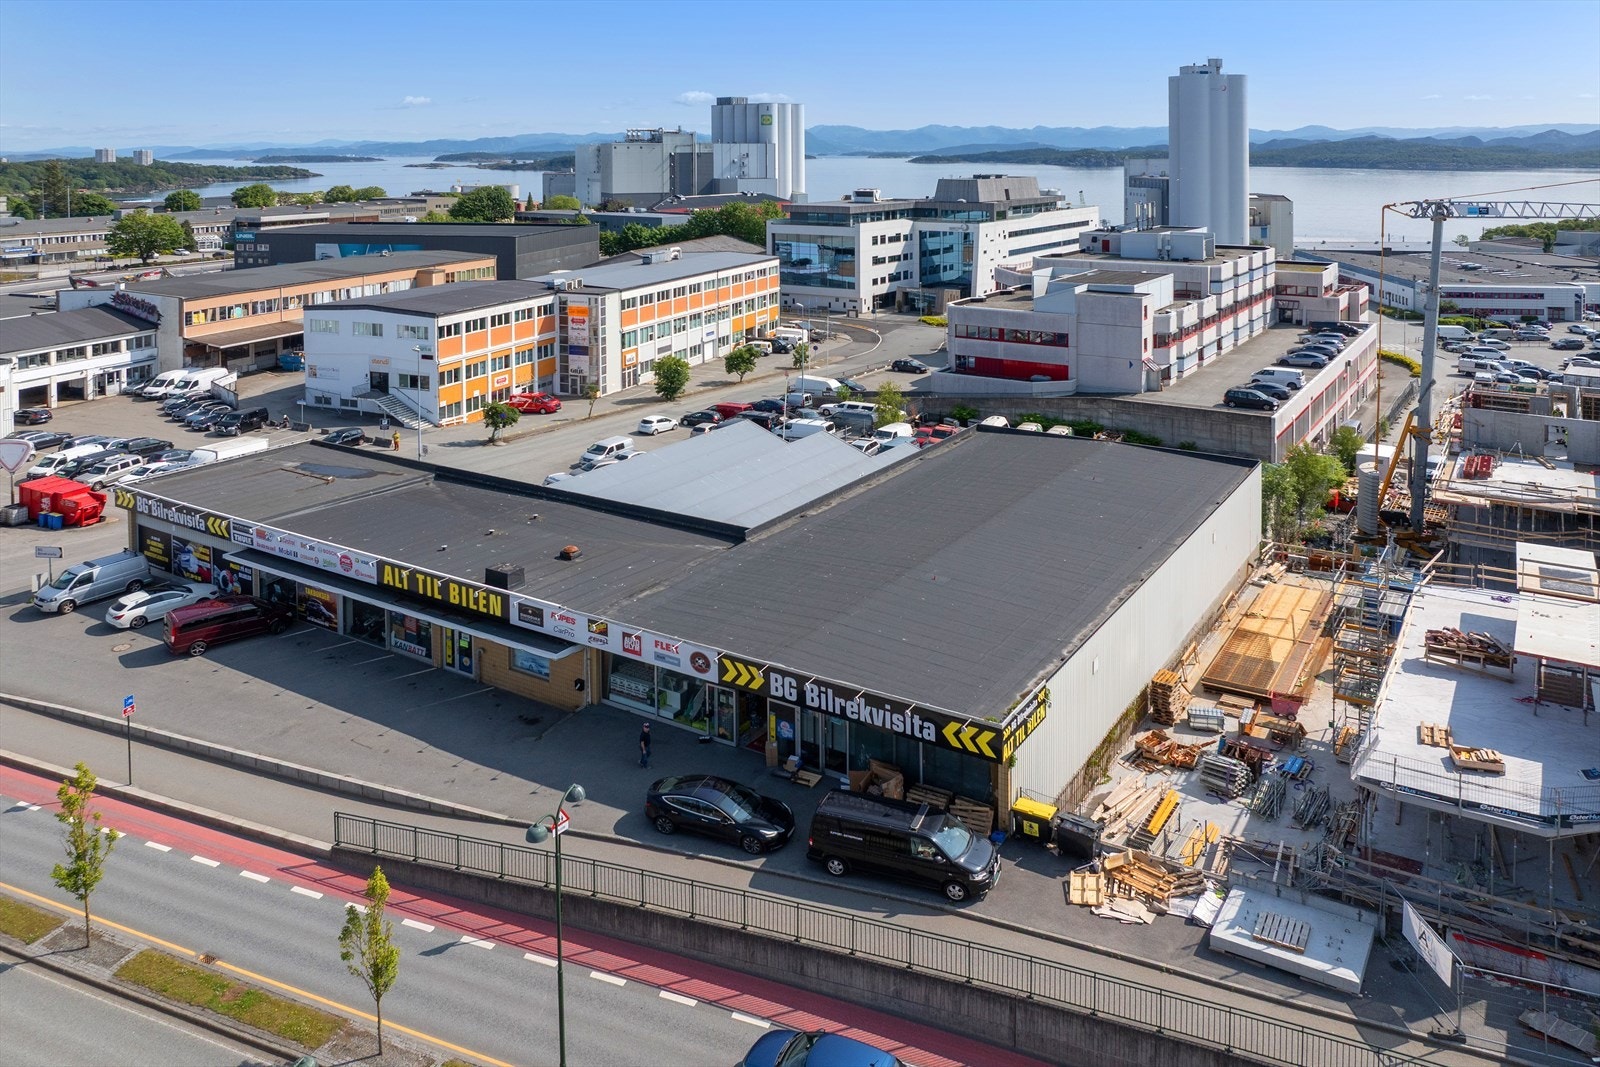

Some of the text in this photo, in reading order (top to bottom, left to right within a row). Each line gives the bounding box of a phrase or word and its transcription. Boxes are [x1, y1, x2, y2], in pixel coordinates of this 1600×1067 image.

[136, 495, 149, 514] BG
[151, 497, 206, 532] Bilrekvisita
[234, 533, 253, 546] THULE
[278, 546, 293, 557] Mobil
[383, 564, 503, 618] ALT TIL BILEN
[553, 625, 575, 638] CarPro
[394, 639, 426, 657] KANBATT
[769, 671, 936, 743] BG Bilrekvisita
[1002, 703, 1046, 762] ALT TIL BILEN
[1380, 781, 1418, 795] ØstrHus
